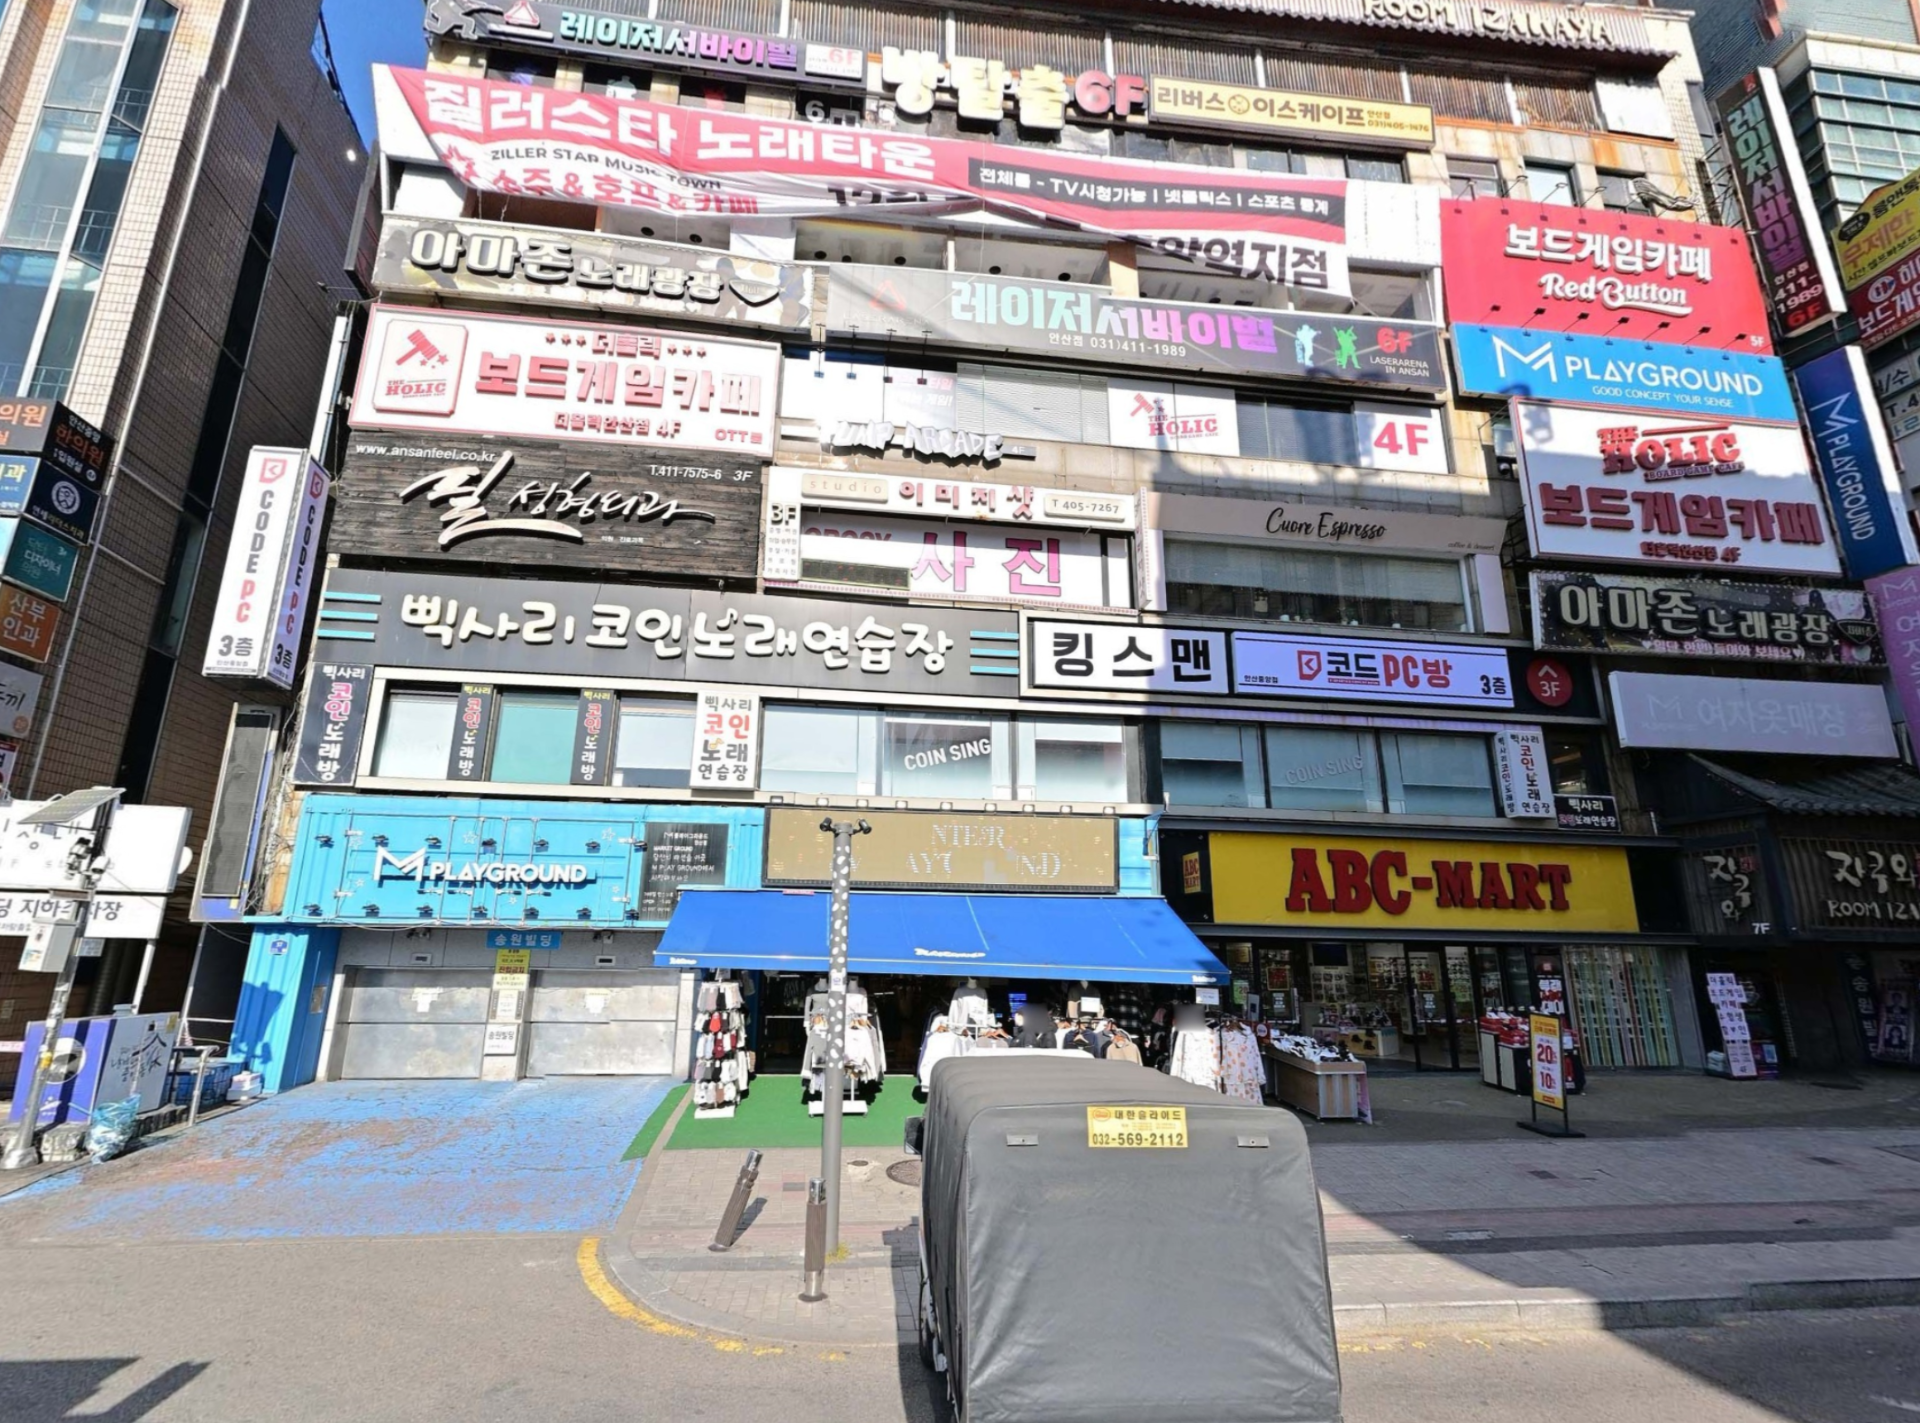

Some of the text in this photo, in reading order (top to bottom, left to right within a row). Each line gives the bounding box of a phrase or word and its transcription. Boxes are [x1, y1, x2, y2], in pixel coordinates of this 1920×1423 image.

[559, 11, 798, 72] 레이저서바이벌
[881, 45, 1070, 130] 방탈출
[1074, 69, 1147, 117] 6F
[1156, 86, 1367, 128] 리버스 이스케이프
[422, 77, 937, 181] 질러스타 노래타운
[490, 147, 548, 162] ZILLER
[1247, 194, 1296, 212] 스포츠
[410, 228, 724, 301] 아마존 노래광장
[1503, 223, 1713, 283] 보드게임카페
[950, 280, 1279, 354] 레이저서바이벌
[1048, 331, 1084, 348] 안산점
[1376, 325, 1413, 355] 6F
[385, 382, 447, 397] HOLIC
[475, 350, 762, 418] 보드게임카페
[1565, 354, 1765, 398] PLAYGROUND
[1592, 385, 1734, 409] GOOD CONCEPT YOUR SENSE
[903, 421, 1004, 464] ARCADE
[1148, 418, 1218, 437] HOLIC
[1373, 420, 1430, 457] 4F
[355, 442, 496, 464] www.ansanfeel.co.kr
[1599, 432, 1742, 475] HOLIC
[732, 470, 753, 482] 3F
[808, 478, 883, 495] studio
[1825, 432, 1877, 541] PLAYGROUND
[771, 502, 797, 526] 3F
[899, 479, 1035, 520] 이미지샷
[1061, 500, 1121, 514] 405-7267
[1538, 482, 1827, 546] 보드게임카페
[245, 489, 275, 574] CODE
[1265, 507, 1389, 542] Cuore Espresso
[294, 504, 317, 587] CODE
[911, 529, 1064, 598] 사진
[9, 592, 46, 623] 산부
[235, 578, 256, 624] PC
[284, 590, 299, 635] PC
[1559, 584, 1831, 646] 아마존 노래광장
[2, 616, 41, 649] 인과
[218, 634, 254, 657] 3층
[1052, 631, 1213, 683] 킹스맨
[1479, 673, 1507, 696] 3층
[1540, 680, 1561, 698] 3F
[703, 713, 751, 740] 코인
[701, 738, 749, 763] 노래
[903, 737, 993, 772] COIN SING
[697, 763, 749, 783] 연습장
[1521, 801, 1551, 814] 연습장
[429, 862, 590, 886] PLAYGROUND
[1284, 847, 1573, 916] ABC-MART
[1827, 899, 1881, 920] ROOM
[1751, 922, 1771, 935] 7F
[1091, 1132, 1185, 1147] 032-569-2112
